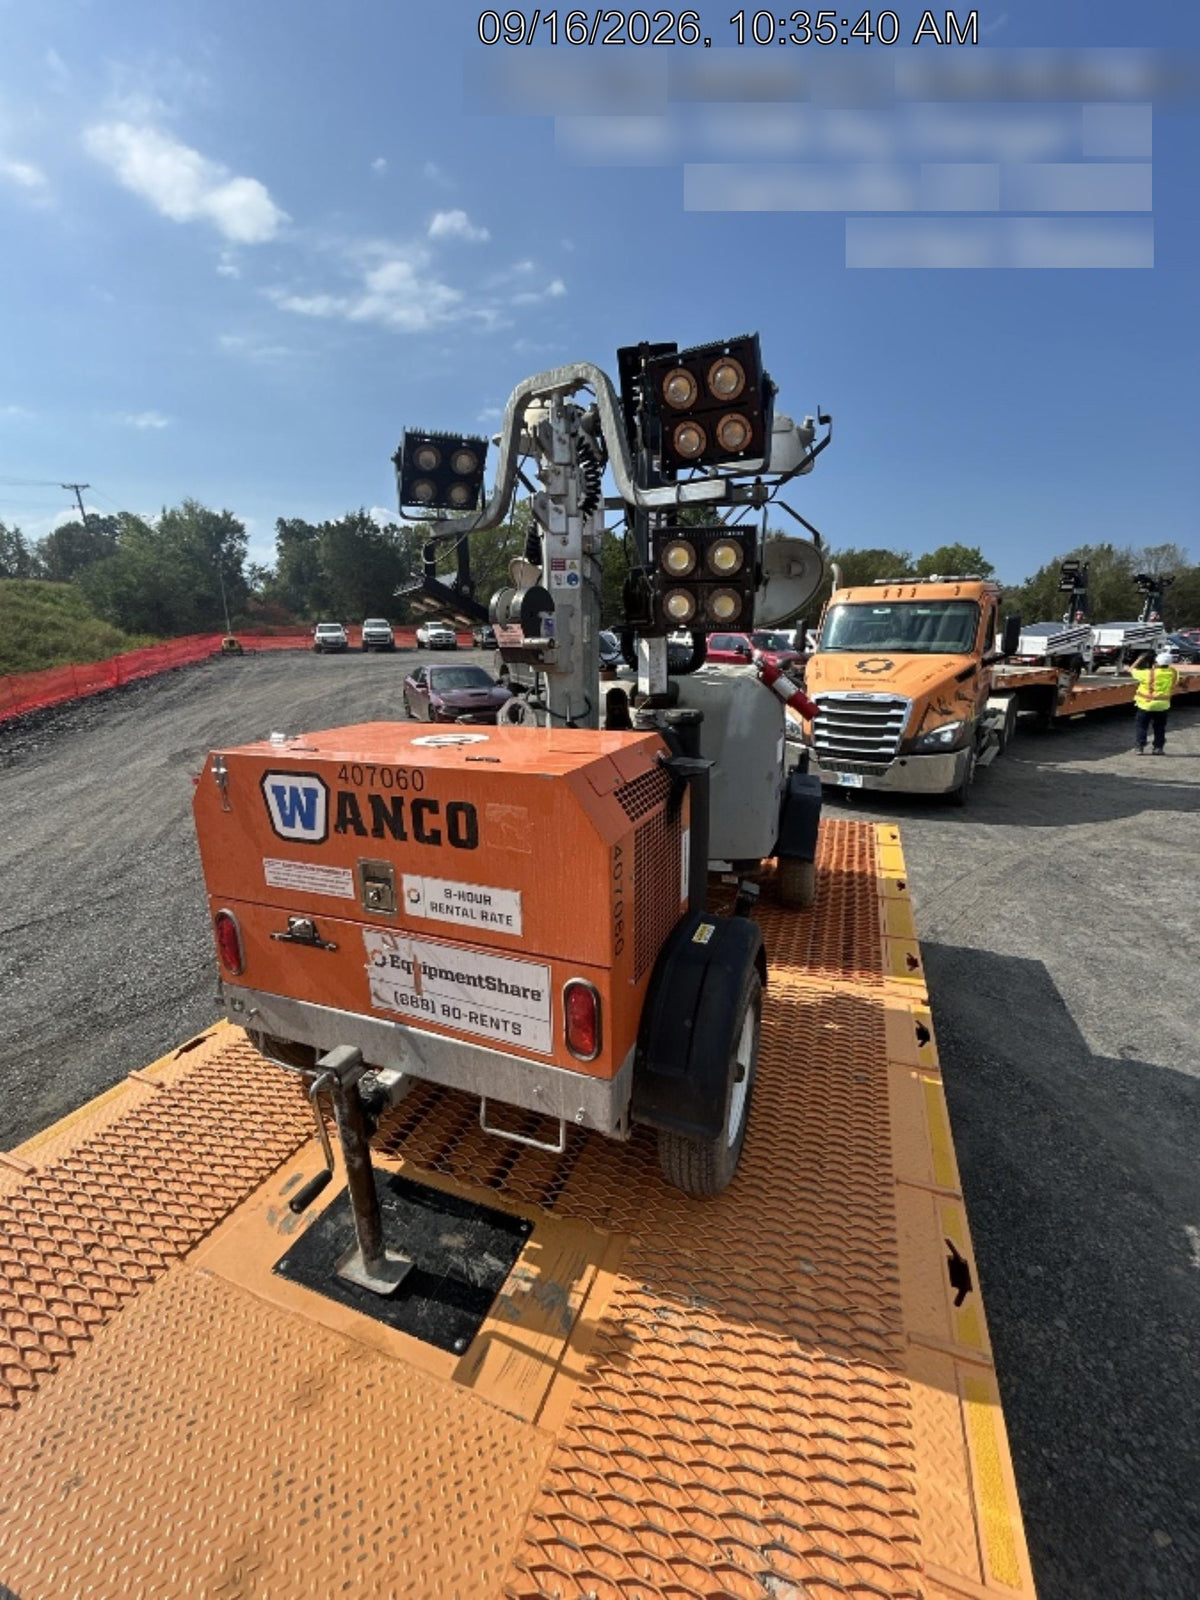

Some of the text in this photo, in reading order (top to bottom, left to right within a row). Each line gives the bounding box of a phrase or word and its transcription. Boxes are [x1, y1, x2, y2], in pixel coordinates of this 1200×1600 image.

[337, 764, 425, 792] 407060
[270, 784, 479, 850] WANCO
[443, 888, 492, 906] 8-HOUR
[429, 901, 513, 927] RENTAL RATE
[393, 990, 522, 1036] (888) 80-RENTS
